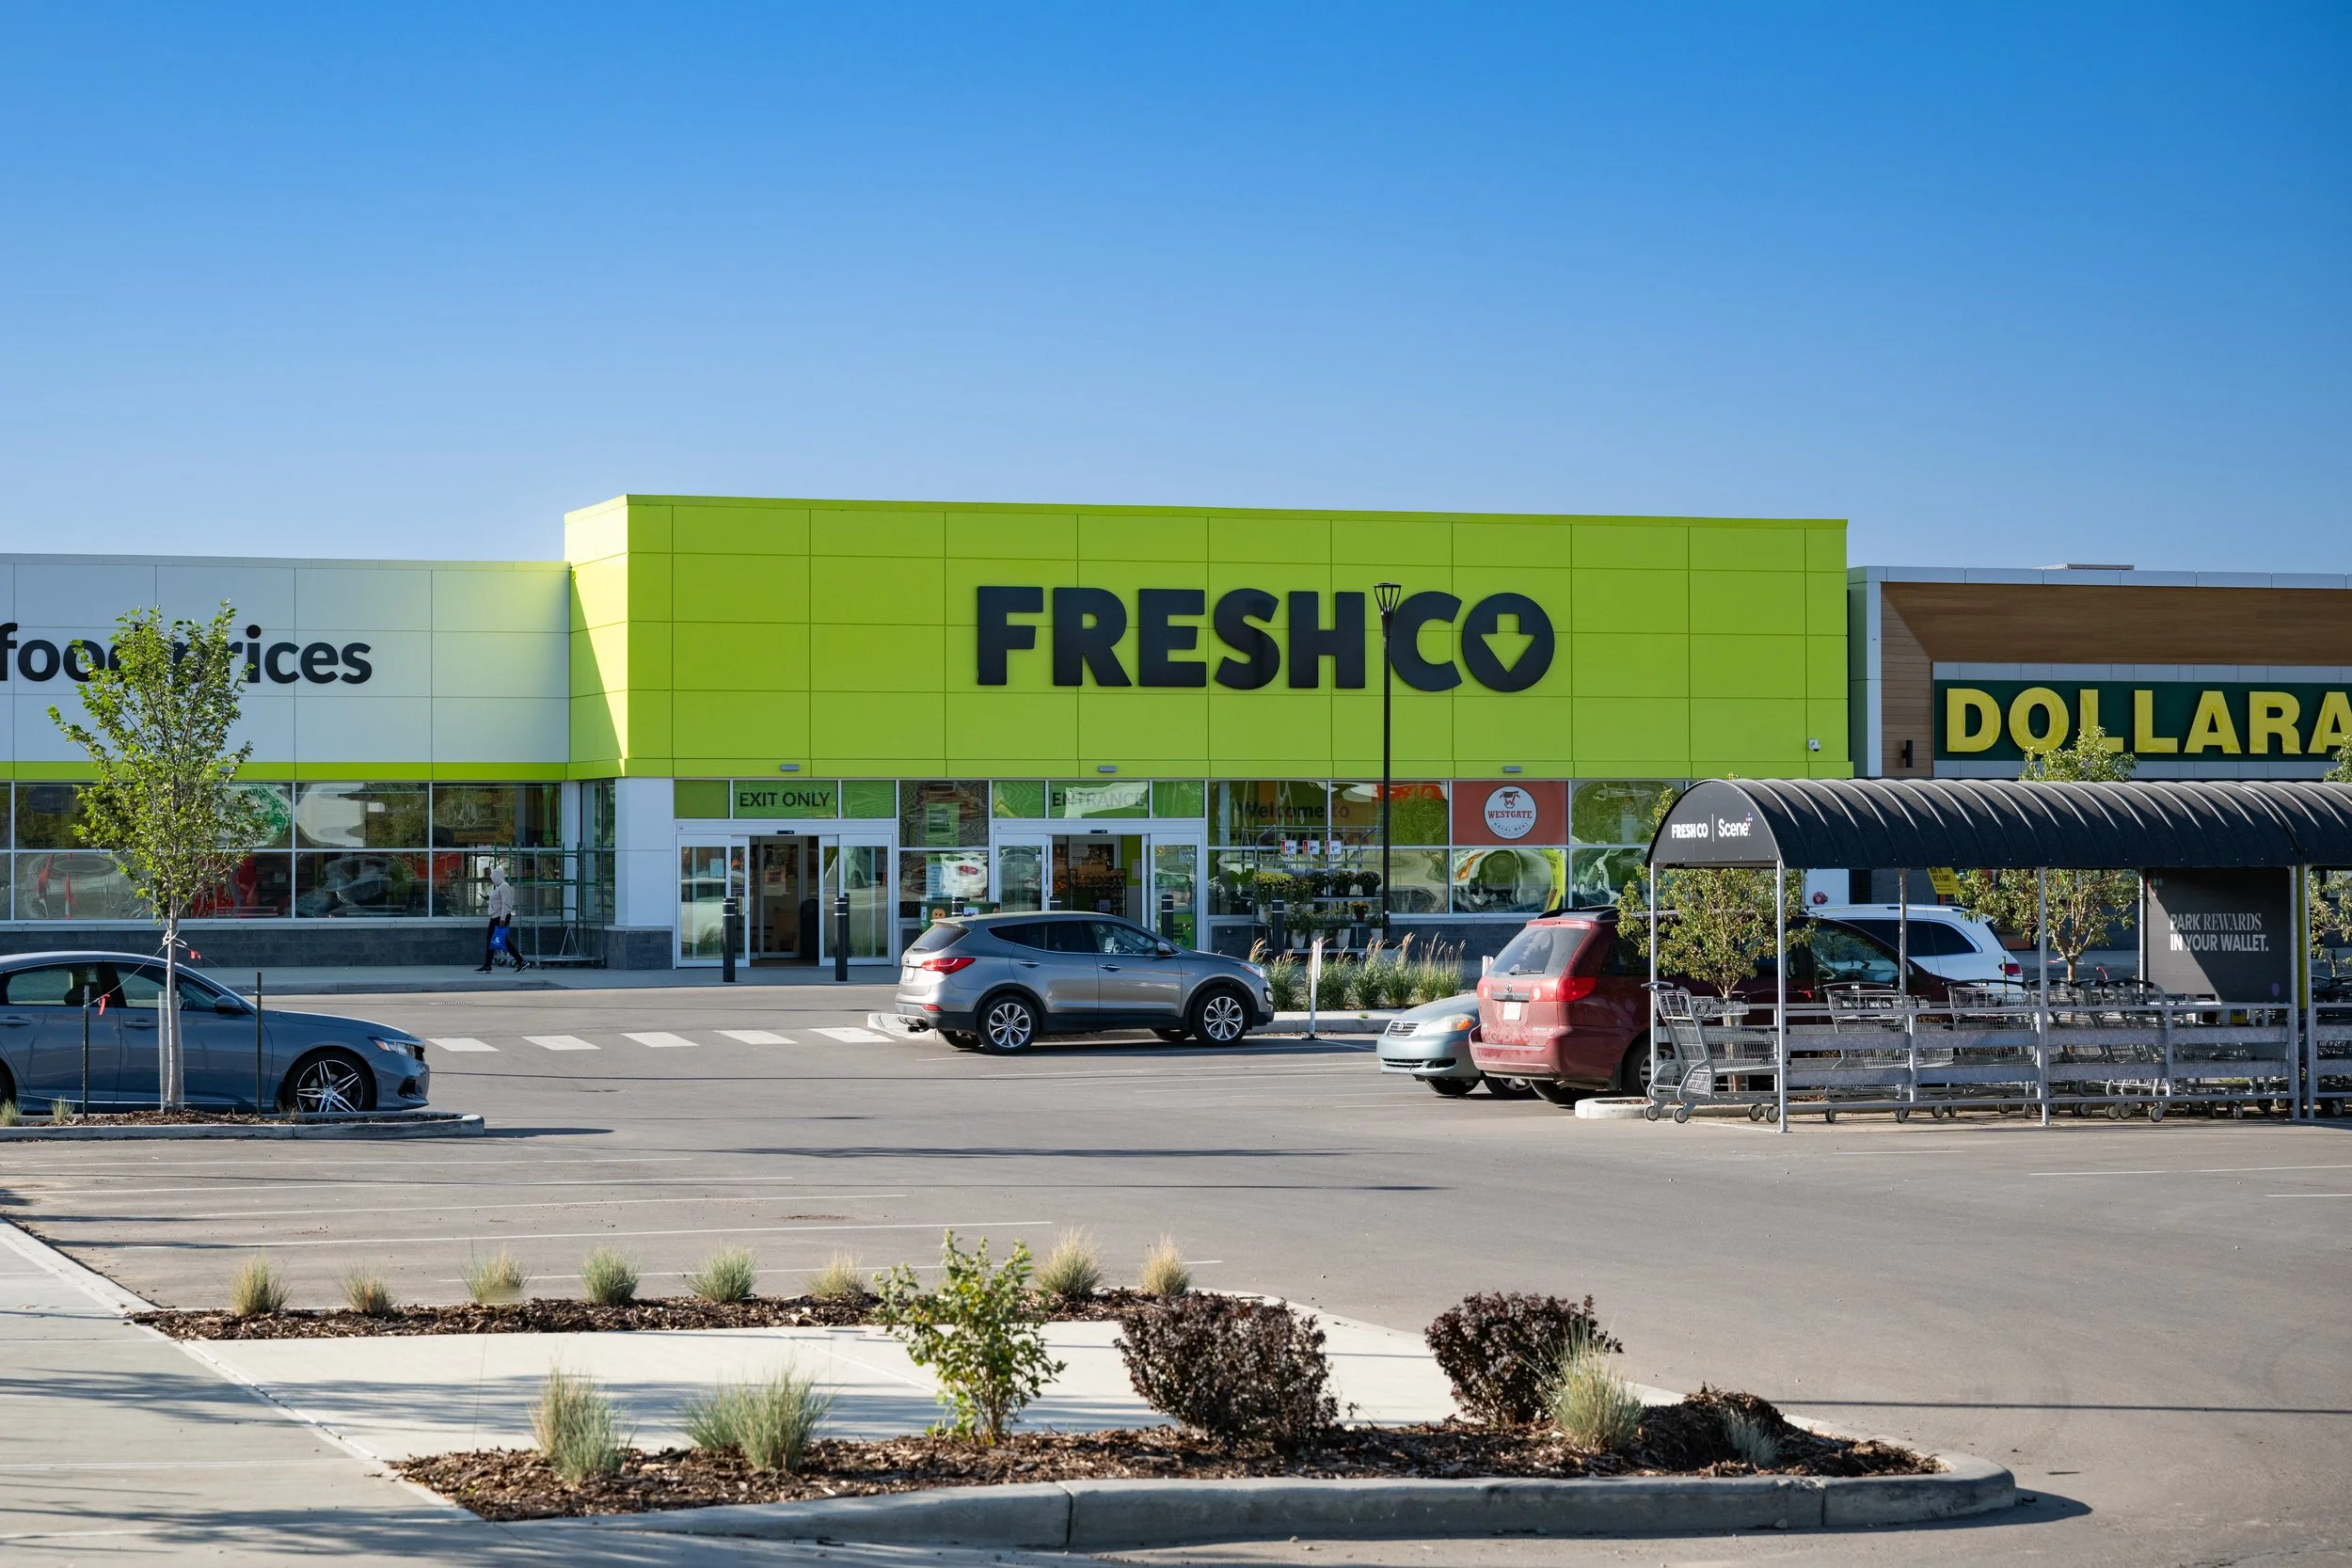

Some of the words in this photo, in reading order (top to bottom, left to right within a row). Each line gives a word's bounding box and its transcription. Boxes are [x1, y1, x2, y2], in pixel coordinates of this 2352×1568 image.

[739, 792, 778, 807] EXIT
[782, 792, 831, 807] ONLY
[1052, 792, 1145, 807] ENTRANCE
[1238, 800, 1326, 818] Welcome
[1487, 810, 1533, 819] WESTGATE
[2169, 913, 2201, 931] PARK
[2203, 912, 2263, 931] REWARDS
[2169, 934, 2183, 952] IN
[2185, 934, 2218, 952] YOUR
[2220, 934, 2269, 952] WALLET.
